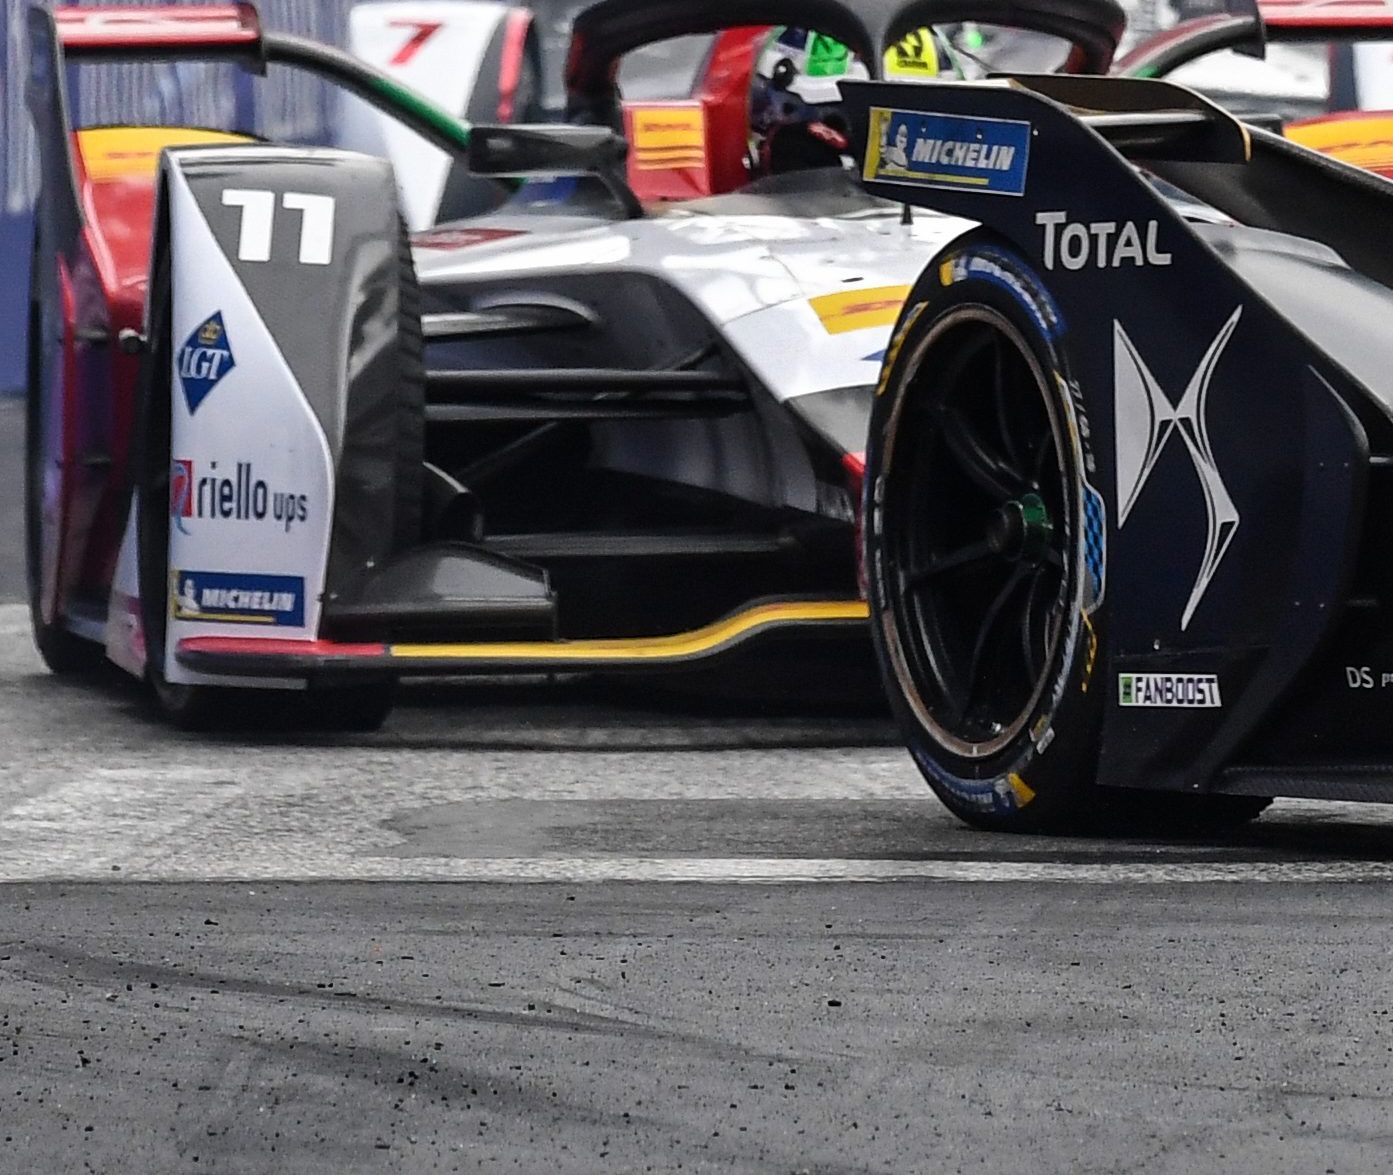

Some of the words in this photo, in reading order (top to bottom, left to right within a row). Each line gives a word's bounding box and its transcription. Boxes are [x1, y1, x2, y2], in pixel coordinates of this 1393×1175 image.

[387, 21, 442, 65] 7
[912, 136, 1015, 172] MICHELIN
[221, 189, 335, 265] 11
[1035, 211, 1173, 270] TOTAL
[181, 347, 228, 380] LGT
[197, 461, 268, 521] riello
[273, 492, 308, 532] ups
[200, 588, 297, 611] MICHELIN
[1134, 676, 1218, 705] FANBOOST
[1345, 666, 1374, 689] DS
